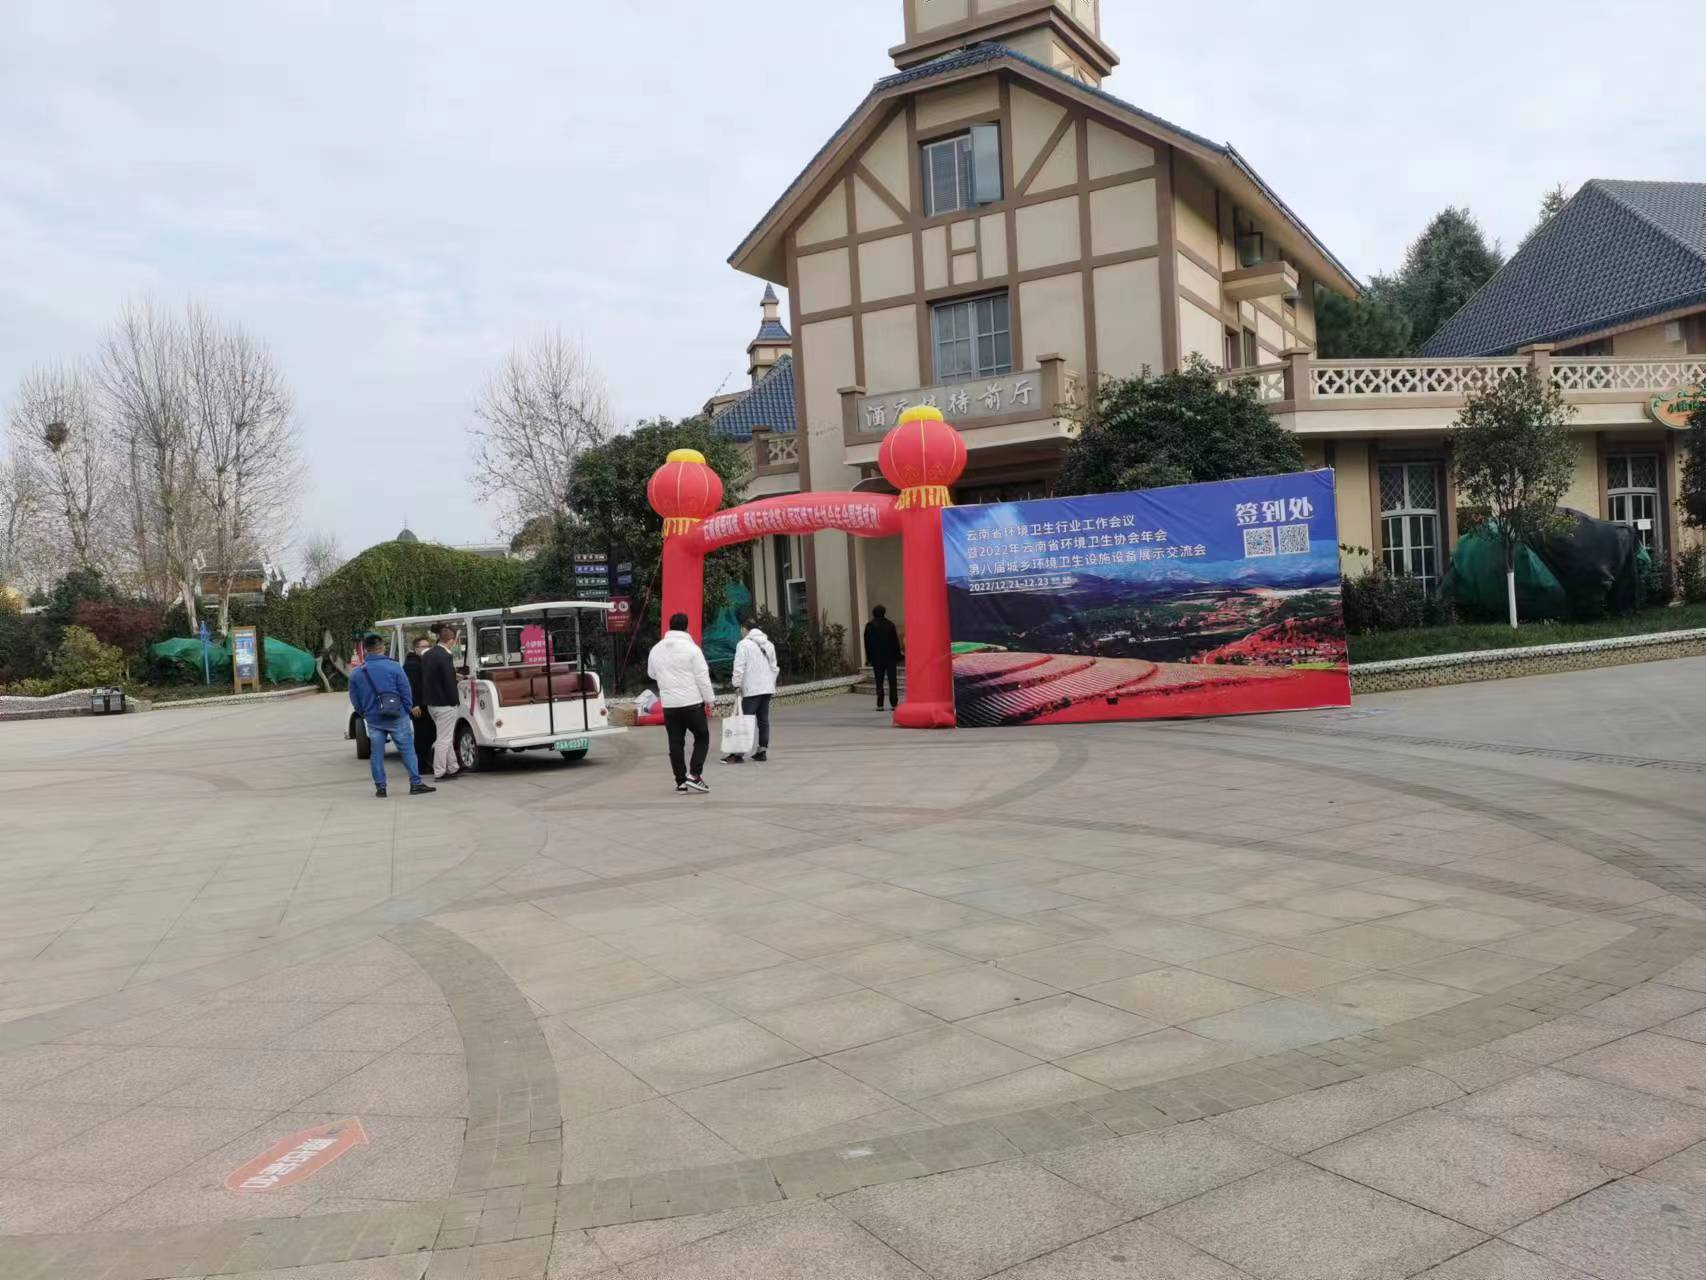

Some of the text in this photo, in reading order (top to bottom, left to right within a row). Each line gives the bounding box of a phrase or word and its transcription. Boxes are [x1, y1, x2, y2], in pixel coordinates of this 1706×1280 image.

[1235, 496, 1314, 526] 签到处
[966, 514, 1136, 541] 云南省环境卫生行业工作会议
[967, 529, 1168, 559] 暨2022年云南省环境卫生协会年会
[968, 543, 1207, 576] 第八届城乡环境卫生设施设备展示交流会
